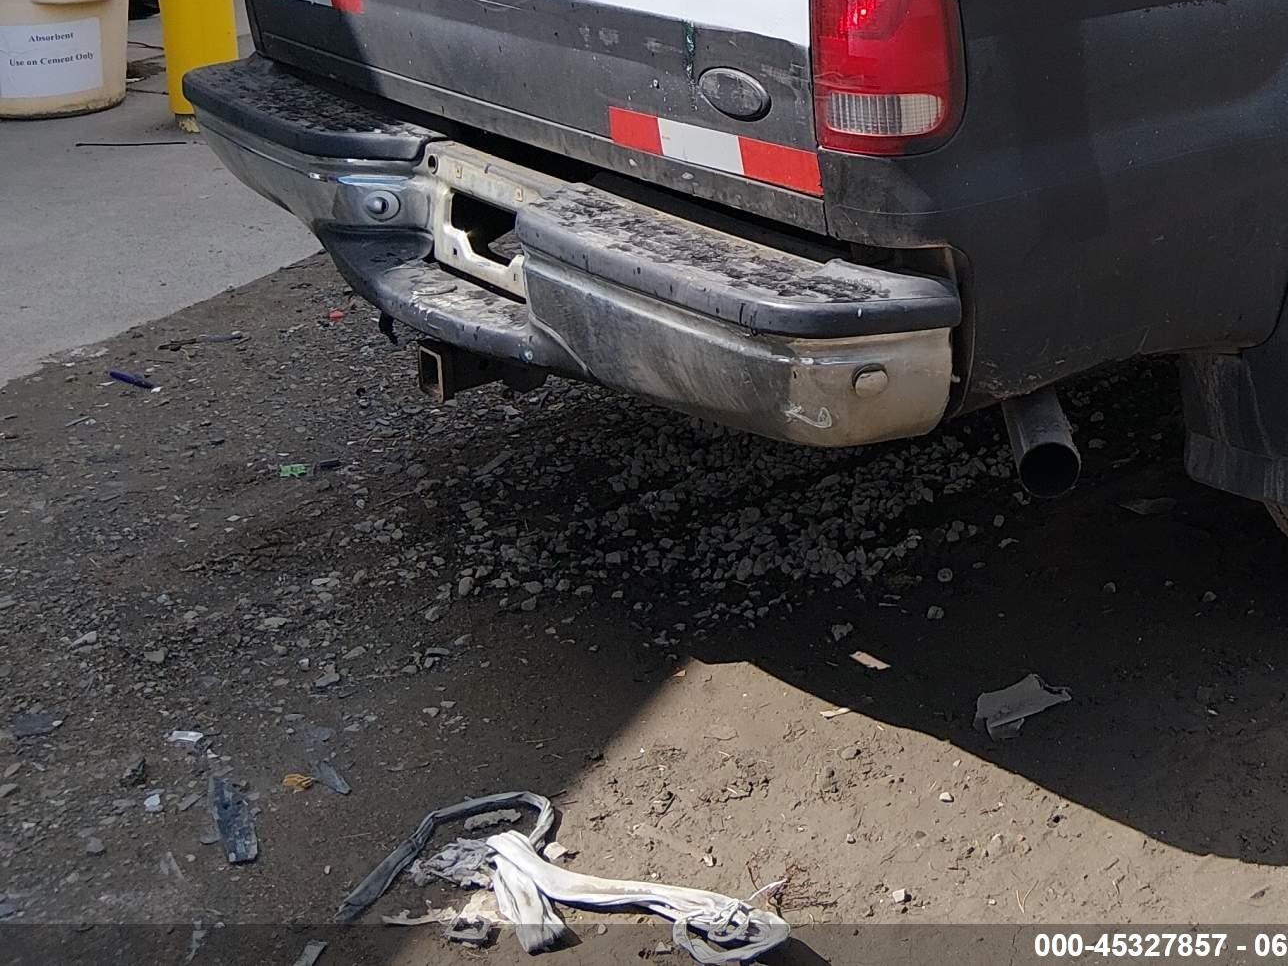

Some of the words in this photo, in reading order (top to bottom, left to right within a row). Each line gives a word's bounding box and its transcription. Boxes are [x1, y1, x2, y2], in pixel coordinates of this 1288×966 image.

[29, 32, 74, 43] Absorbent
[9, 58, 25, 67] Use
[40, 56, 74, 65] Cement
[75, 52, 94, 61] Only
